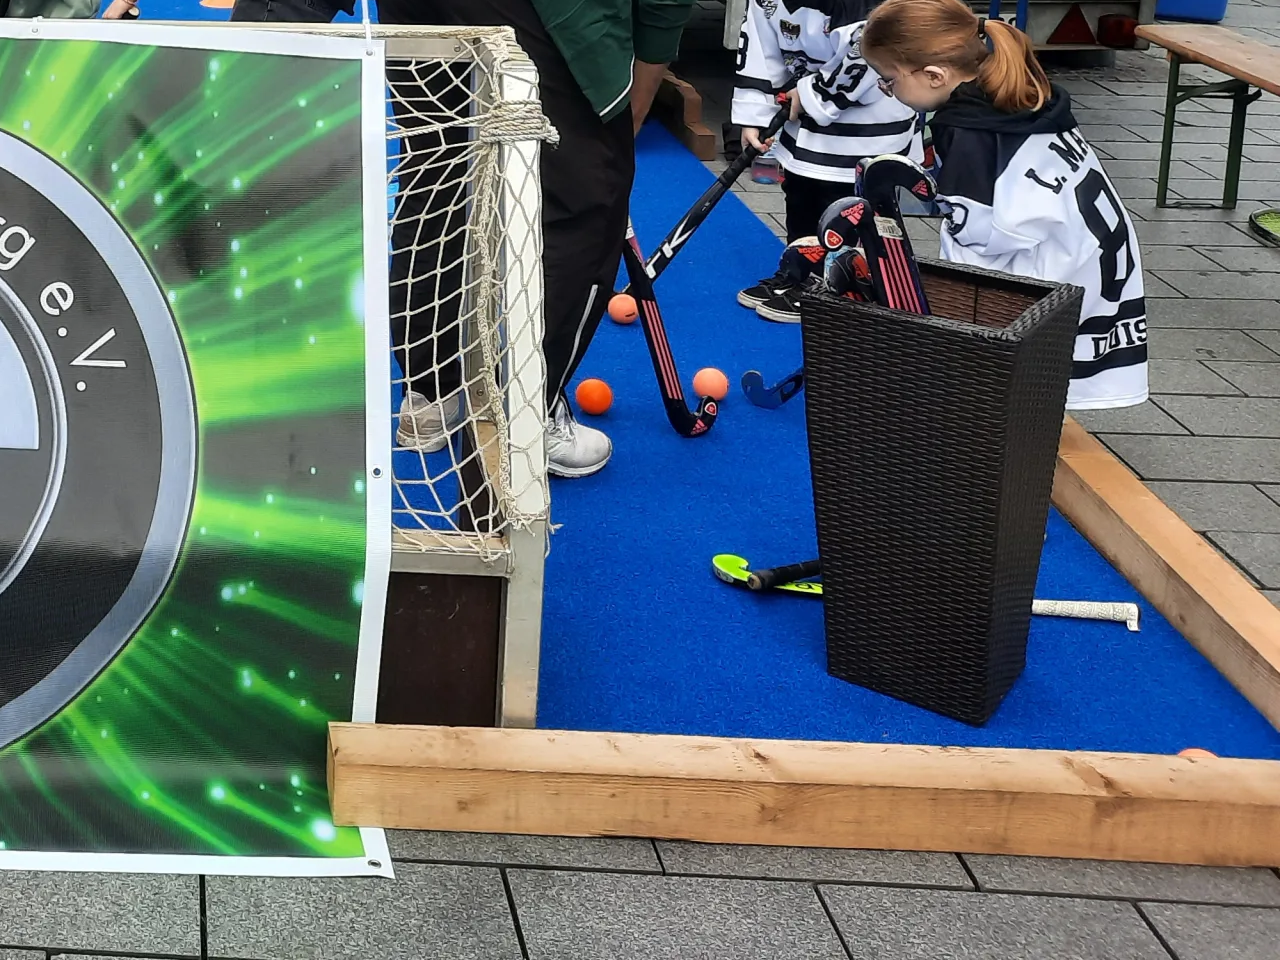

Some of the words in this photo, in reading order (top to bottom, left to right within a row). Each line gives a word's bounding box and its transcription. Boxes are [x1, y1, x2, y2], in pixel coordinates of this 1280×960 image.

[1025, 167, 1068, 195] L.
[1074, 167, 1135, 302] 8
[39, 281, 128, 393] e.V.
